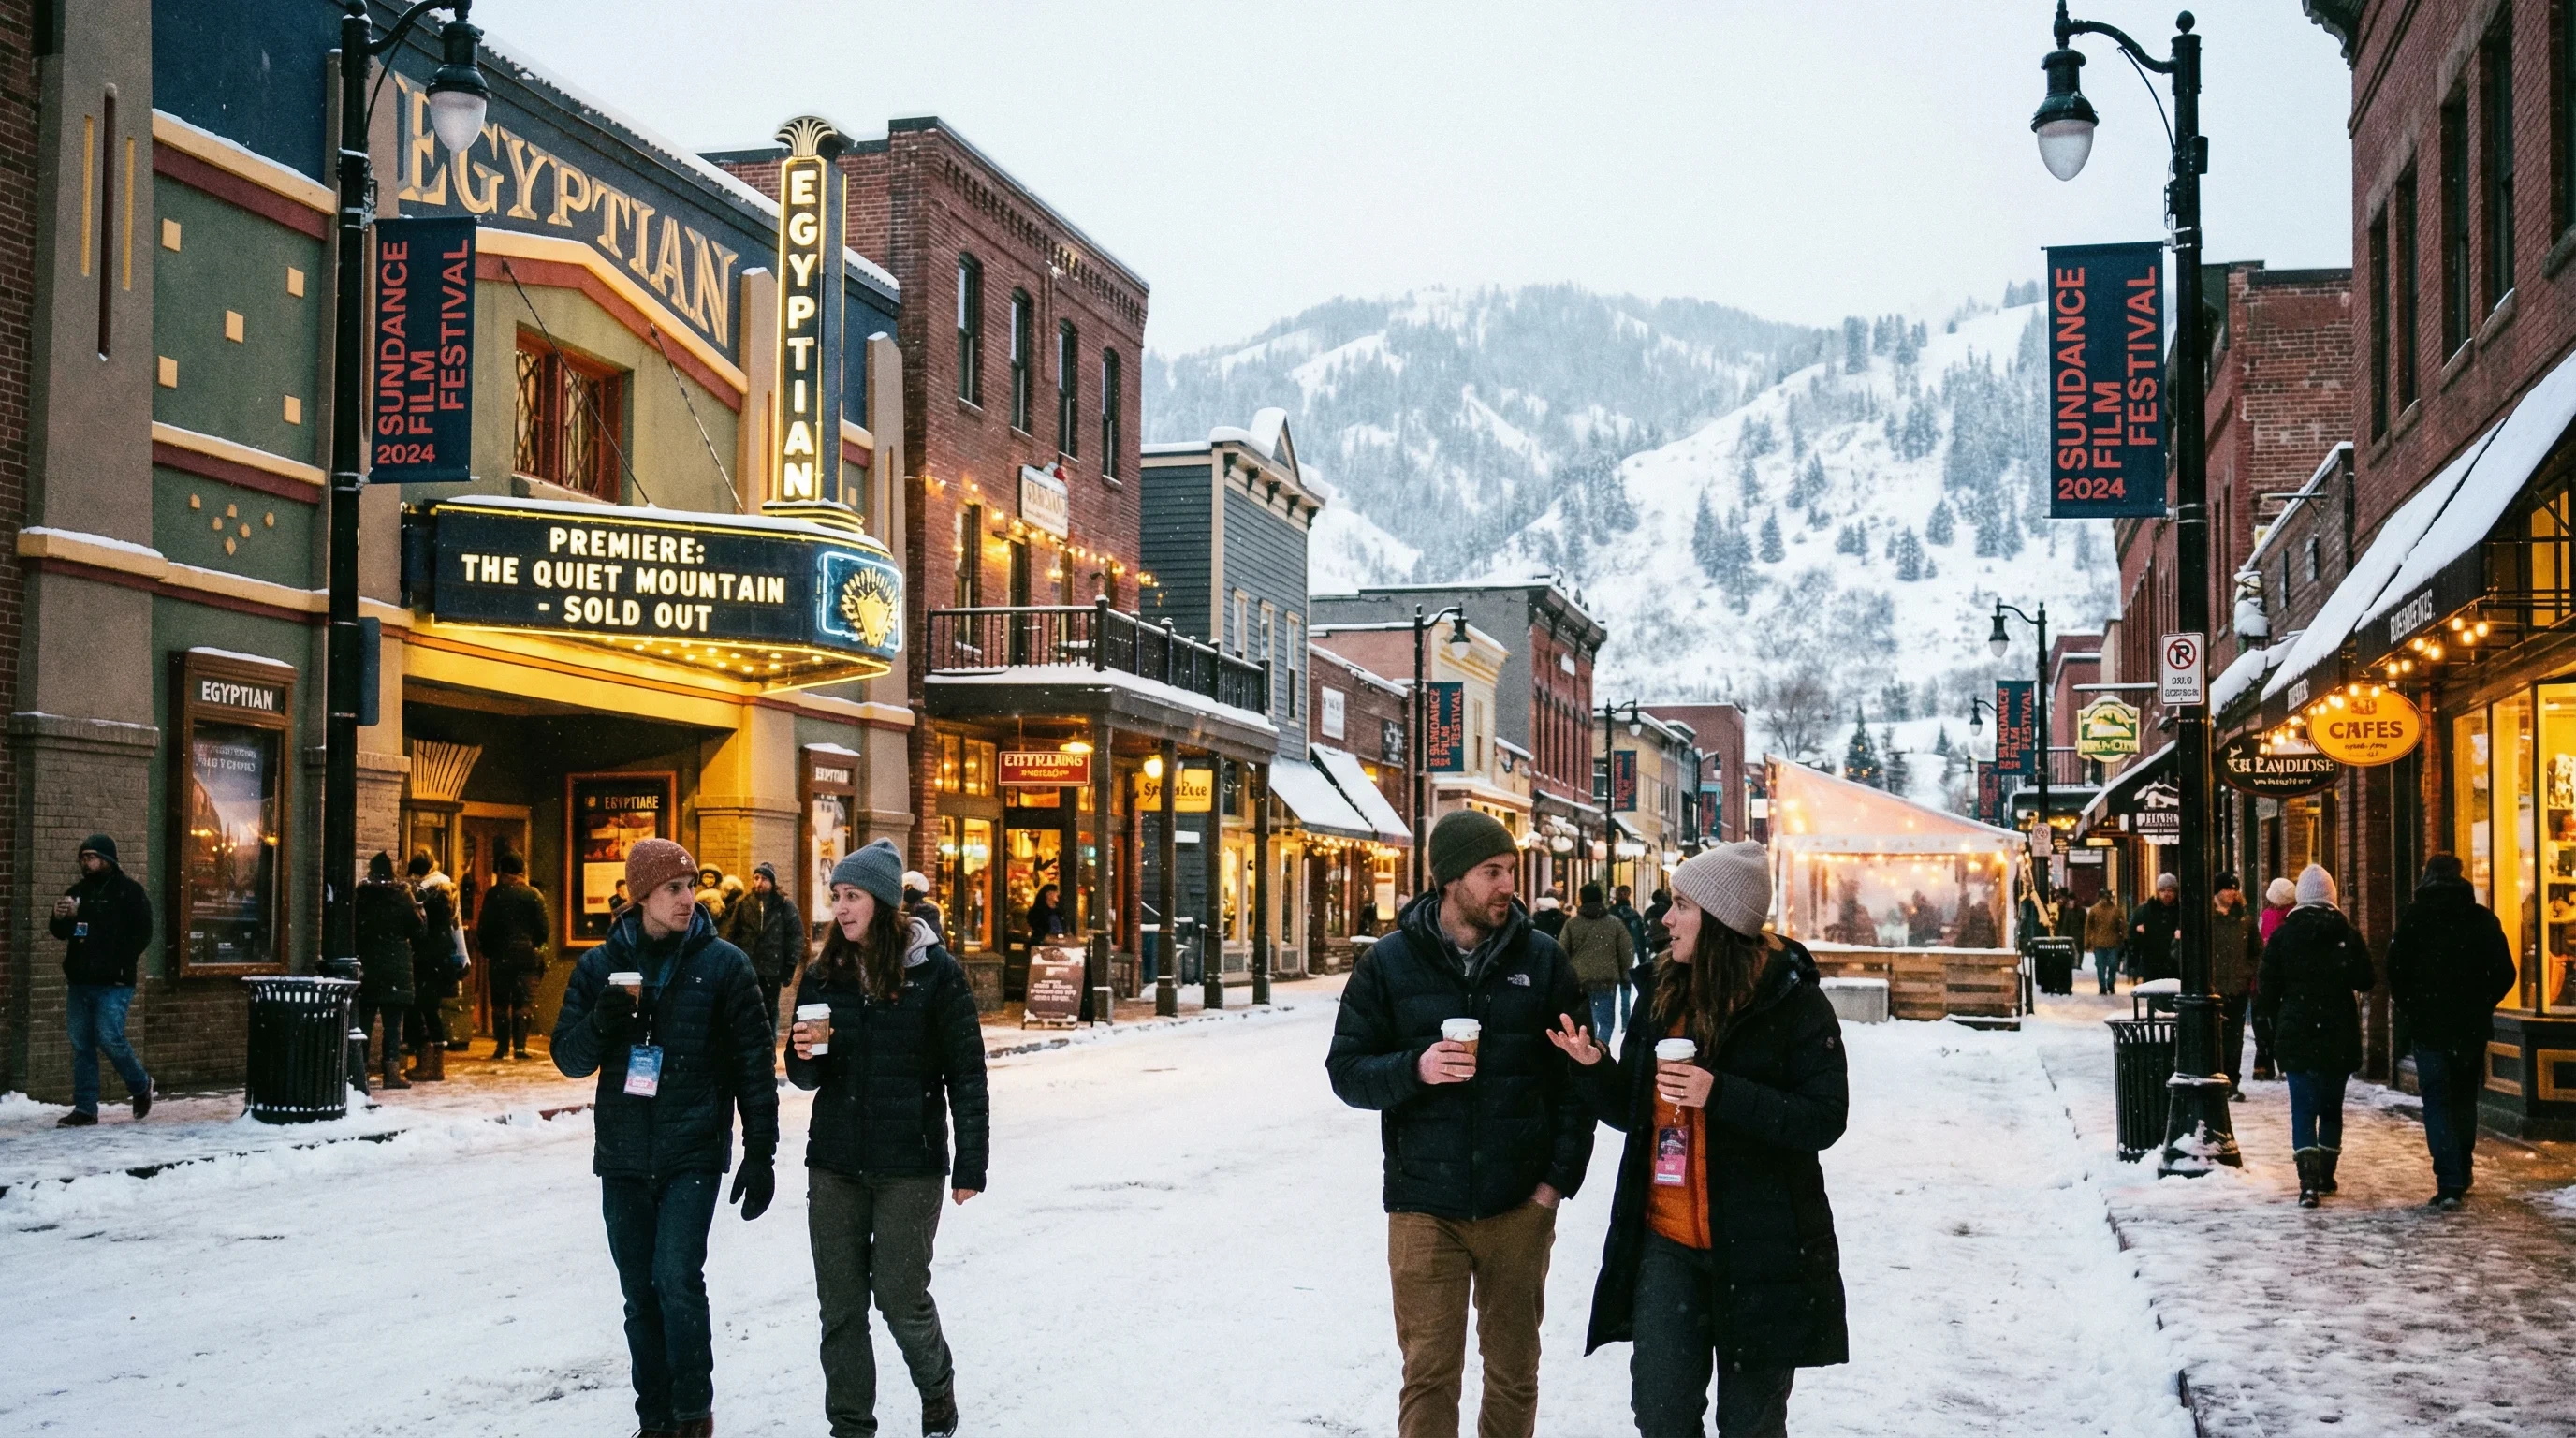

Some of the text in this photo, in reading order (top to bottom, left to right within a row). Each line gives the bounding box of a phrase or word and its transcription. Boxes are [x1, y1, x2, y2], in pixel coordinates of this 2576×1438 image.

[395, 70, 739, 349] EGYPTIAN
[377, 240, 409, 437] SUNDANCE
[439, 239, 469, 411] FESTIVAL
[783, 169, 819, 498] EGYPTIAN
[2126, 266, 2159, 447] FESTIVAL
[408, 349, 436, 435] FILM
[2055, 266, 2086, 472] SUNDANCE
[377, 444, 436, 465] 2024
[2092, 381, 2123, 470] FILM
[2057, 477, 2126, 500] 2024
[461, 553, 785, 605] THE QUIET MOUNTAIN
[549, 526, 706, 565] PREMIERE:
[564, 595, 641, 626] SOLD
[654, 602, 713, 633] OUT
[201, 681, 273, 711] EGYPTIAN
[2328, 720, 2405, 740] CAFES
